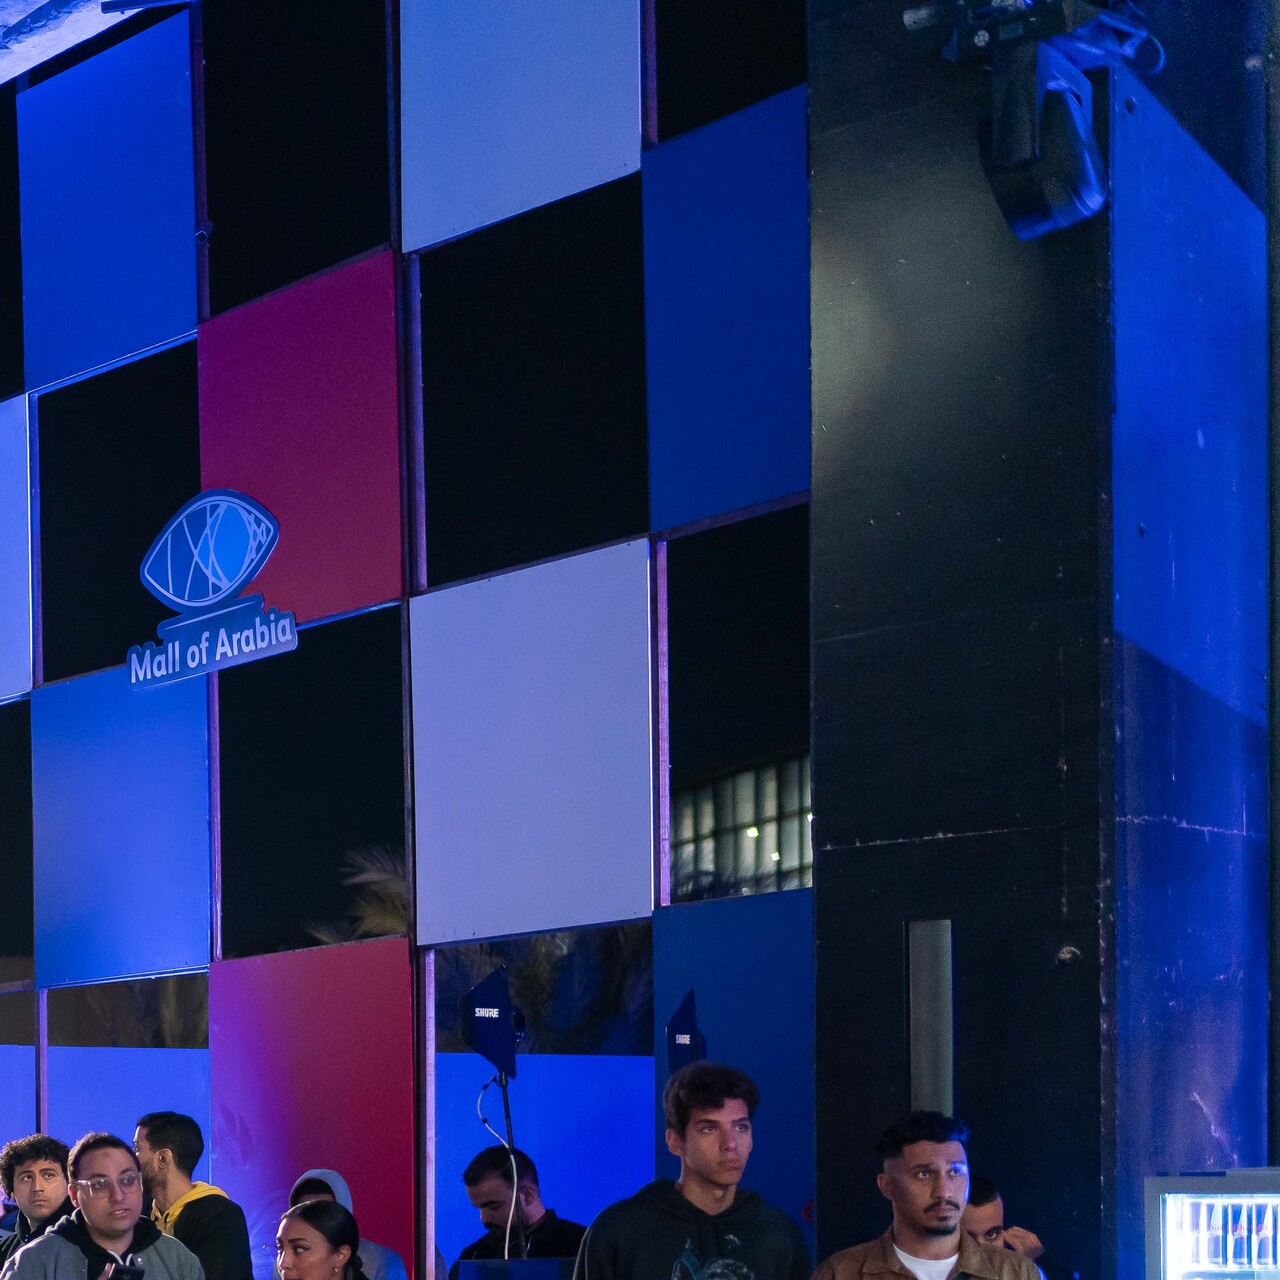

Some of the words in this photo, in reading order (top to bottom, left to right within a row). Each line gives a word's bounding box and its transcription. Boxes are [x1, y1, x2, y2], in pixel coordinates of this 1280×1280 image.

[131, 640, 180, 683] Mall
[187, 631, 210, 668] of
[216, 613, 292, 661] Arabia
[475, 1007, 499, 1018] SHURE
